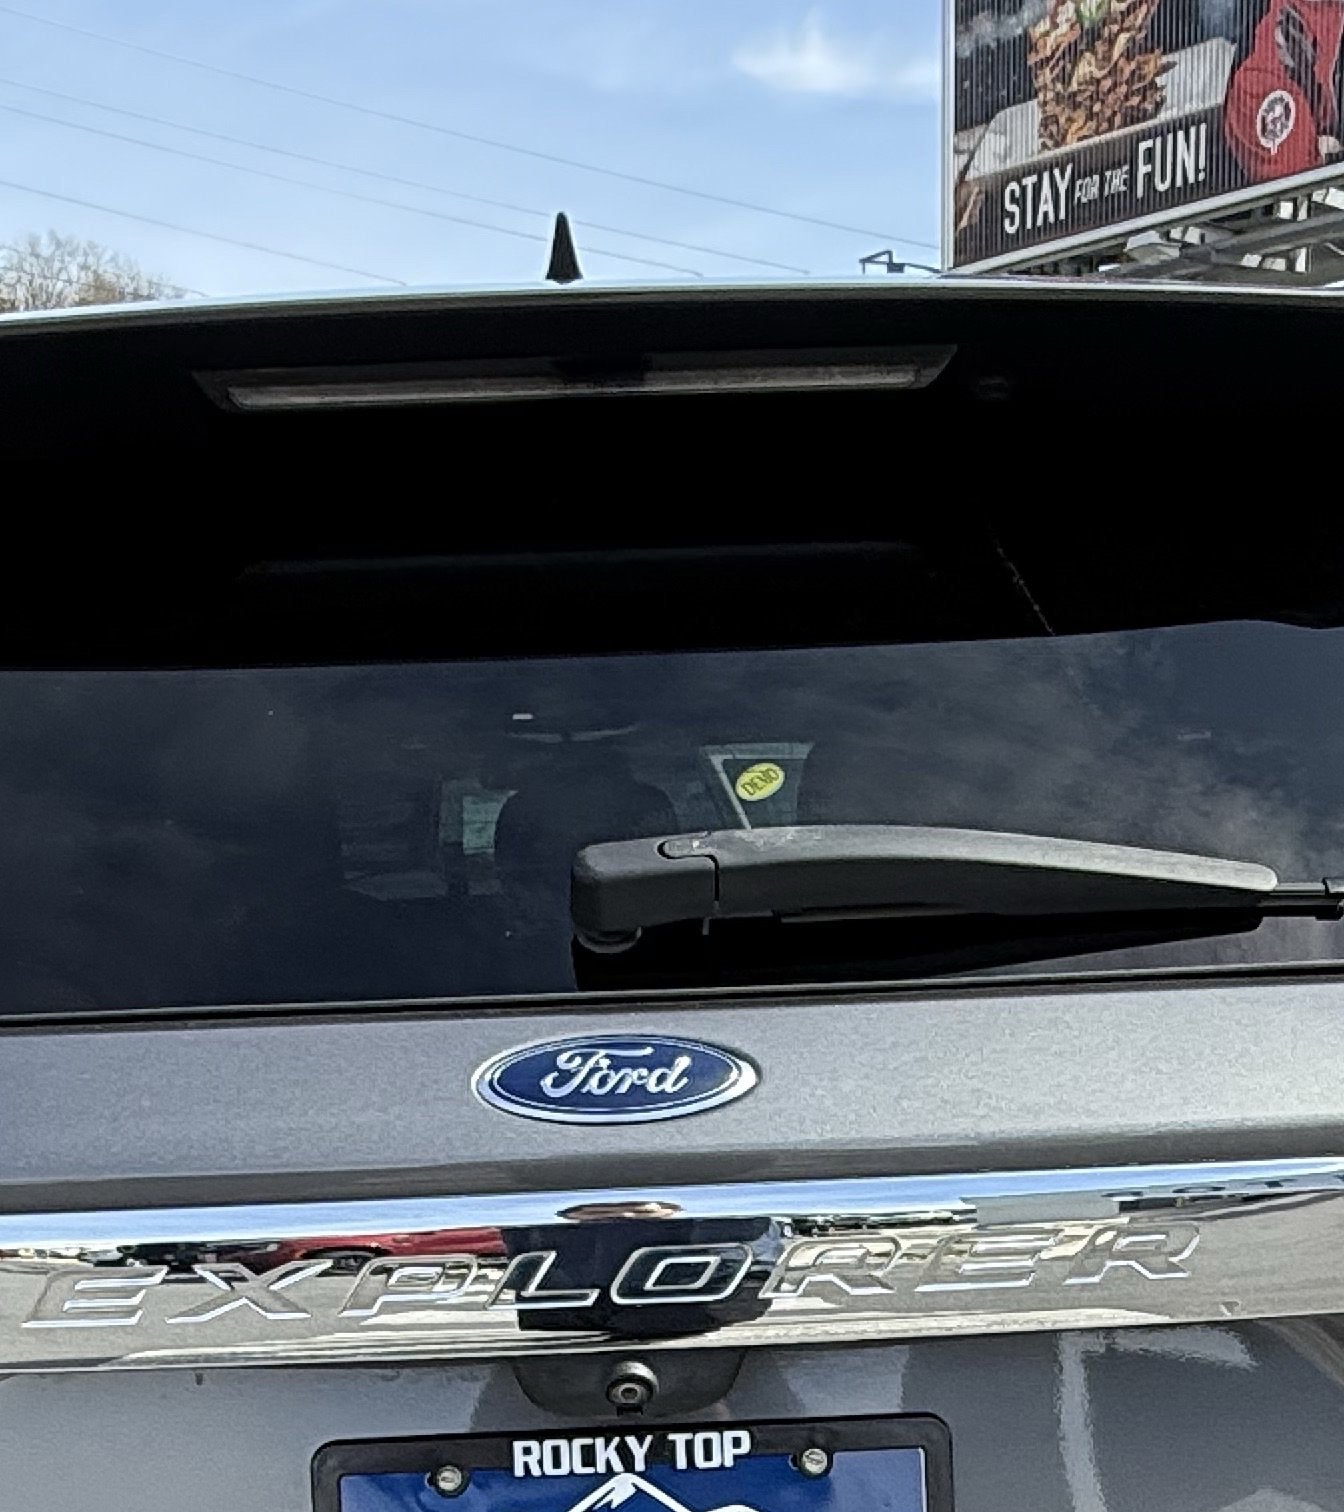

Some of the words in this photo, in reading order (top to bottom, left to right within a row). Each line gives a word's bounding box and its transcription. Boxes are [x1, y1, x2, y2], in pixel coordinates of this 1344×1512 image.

[1004, 162, 1073, 234] STAY
[1074, 174, 1100, 205] FOR
[1105, 164, 1130, 198] THE
[1137, 122, 1207, 200] FUN!
[540, 1046, 692, 1098] Ford
[22, 1222, 1202, 1328] EXPLORER
[513, 1434, 654, 1477] ROCKY
[668, 1429, 752, 1470] TOP
